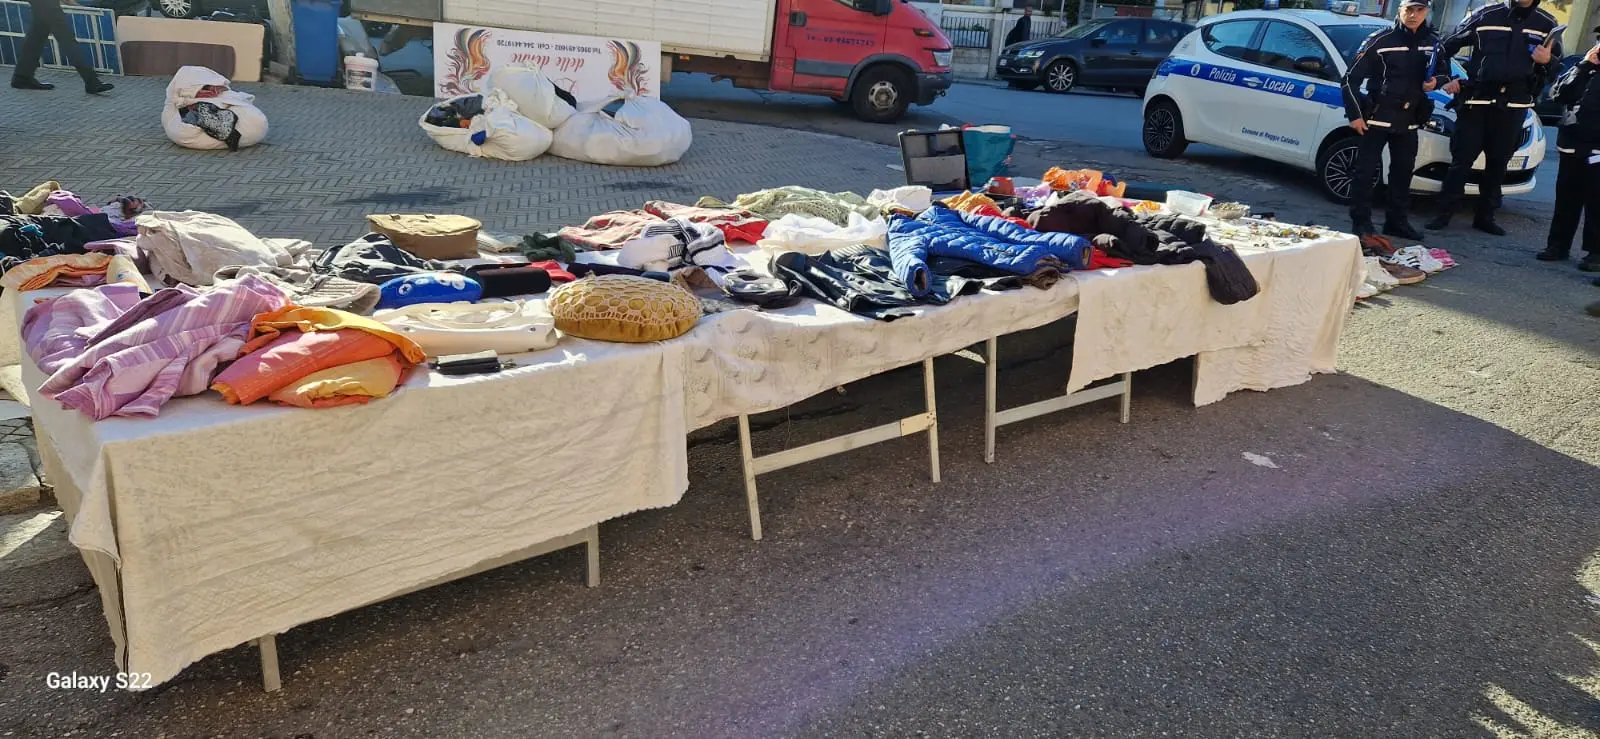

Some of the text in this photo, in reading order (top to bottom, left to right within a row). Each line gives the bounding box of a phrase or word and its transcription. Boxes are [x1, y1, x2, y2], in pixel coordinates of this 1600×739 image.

[556, 56, 585, 72] delle
[1209, 67, 1295, 94] Polizia Locale
[1241, 127, 1259, 136] Comune
[1264, 132, 1280, 142] Reggio
[1280, 135, 1300, 146] Calabria
